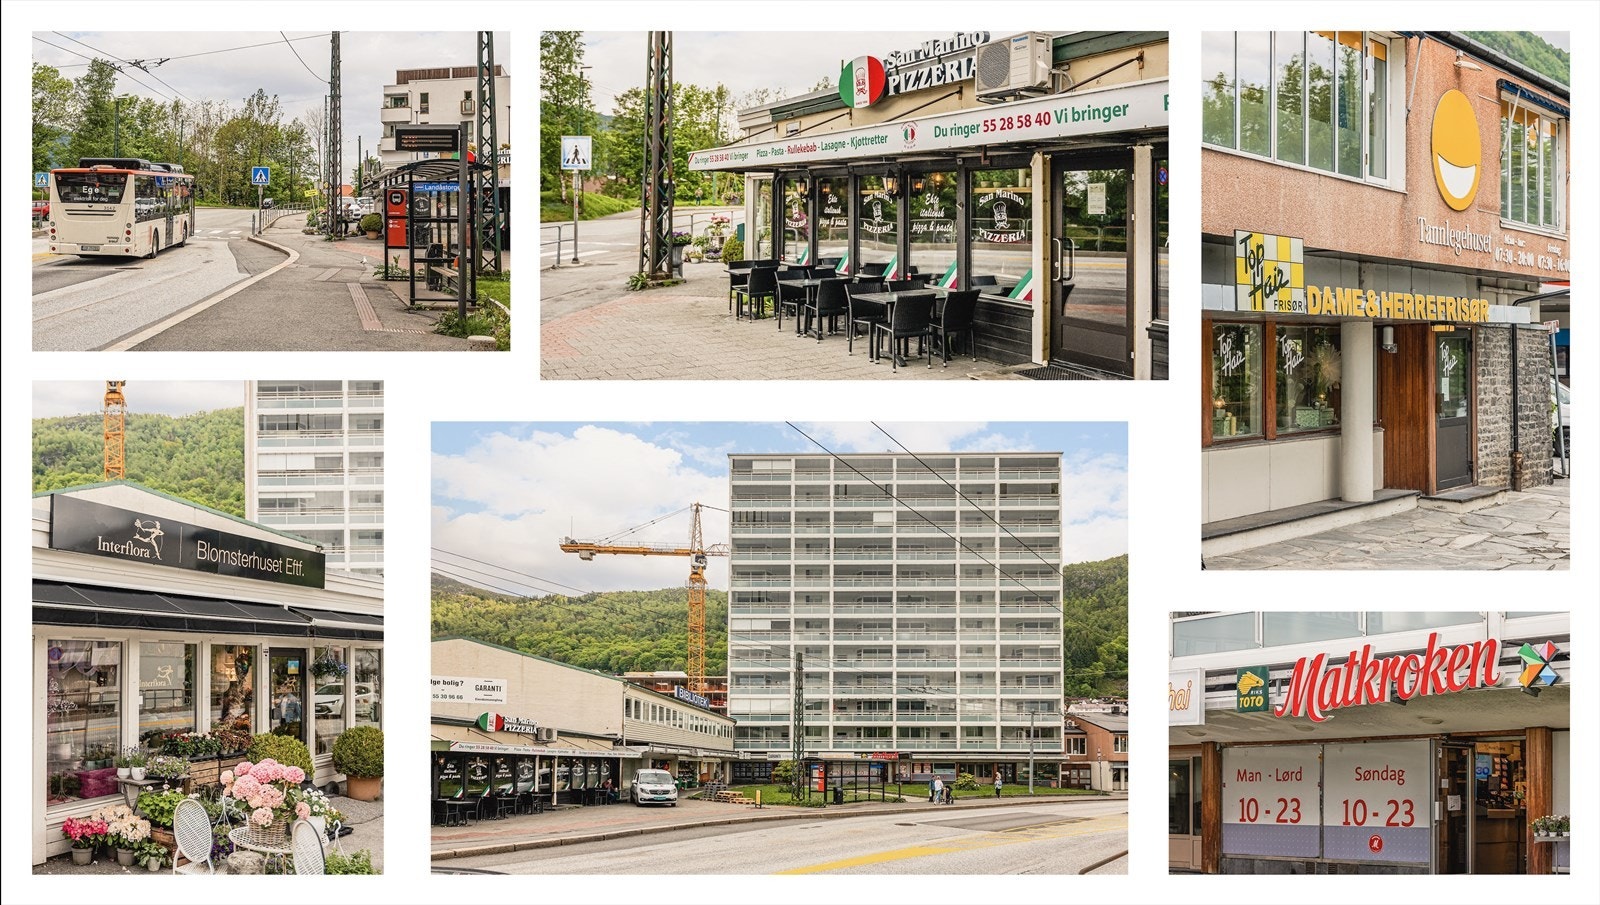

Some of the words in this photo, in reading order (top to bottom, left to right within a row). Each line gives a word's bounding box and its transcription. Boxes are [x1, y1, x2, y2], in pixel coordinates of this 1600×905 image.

[887, 50, 916, 69] San
[919, 31, 985, 60] Marino
[888, 56, 976, 96] PIZZERIA
[934, 125, 948, 138] Du
[950, 122, 981, 138] ringer
[983, 118, 996, 133] 55
[1000, 116, 1014, 131] 28
[1017, 114, 1032, 128] 58
[1034, 111, 1050, 126] 40
[1054, 109, 1068, 124] Vi
[1072, 103, 1129, 126] bringer
[734, 152, 749, 161] bringer
[756, 149, 768, 157] Pizza
[771, 148, 784, 156] Pasta
[787, 144, 817, 154] Rullekebab
[821, 141, 846, 153] Lasagne
[850, 134, 888, 150] Kjøttretter
[978, 192, 993, 206] San
[995, 189, 1024, 206] Marino
[920, 208, 945, 217] italiensk
[864, 222, 893, 234] PIZZERIA
[910, 222, 927, 233] pizza
[936, 224, 953, 233] pasta
[979, 228, 1026, 243] PIZZERIA
[1418, 217, 1492, 256] Tannlegehuset
[1239, 234, 1264, 274] Top
[1495, 247, 1512, 264] 07:30
[1248, 266, 1289, 310] Hair
[1274, 300, 1303, 311] FRISØR
[1218, 333, 1231, 358] Top
[1280, 335, 1292, 358] Top
[1222, 350, 1245, 376] Hair
[1284, 351, 1304, 375] Hair
[98, 536, 150, 558] Interflora
[197, 541, 282, 574] Blomsterhuset
[285, 559, 305, 576] Eftf.
[1274, 632, 1502, 722] Matkroken
[679, 688, 708, 708] BIBLIOTEK
[1240, 696, 1264, 708] TOTO
[504, 724, 537, 734] PIZZERIA
[1237, 769, 1262, 782] Man
[1276, 766, 1302, 782] Lørd
[1355, 766, 1405, 785] Søndag
[1239, 798, 1258, 822] 10
[1276, 798, 1302, 823] 23
[1342, 799, 1367, 826] 10
[1386, 799, 1415, 827] 23
